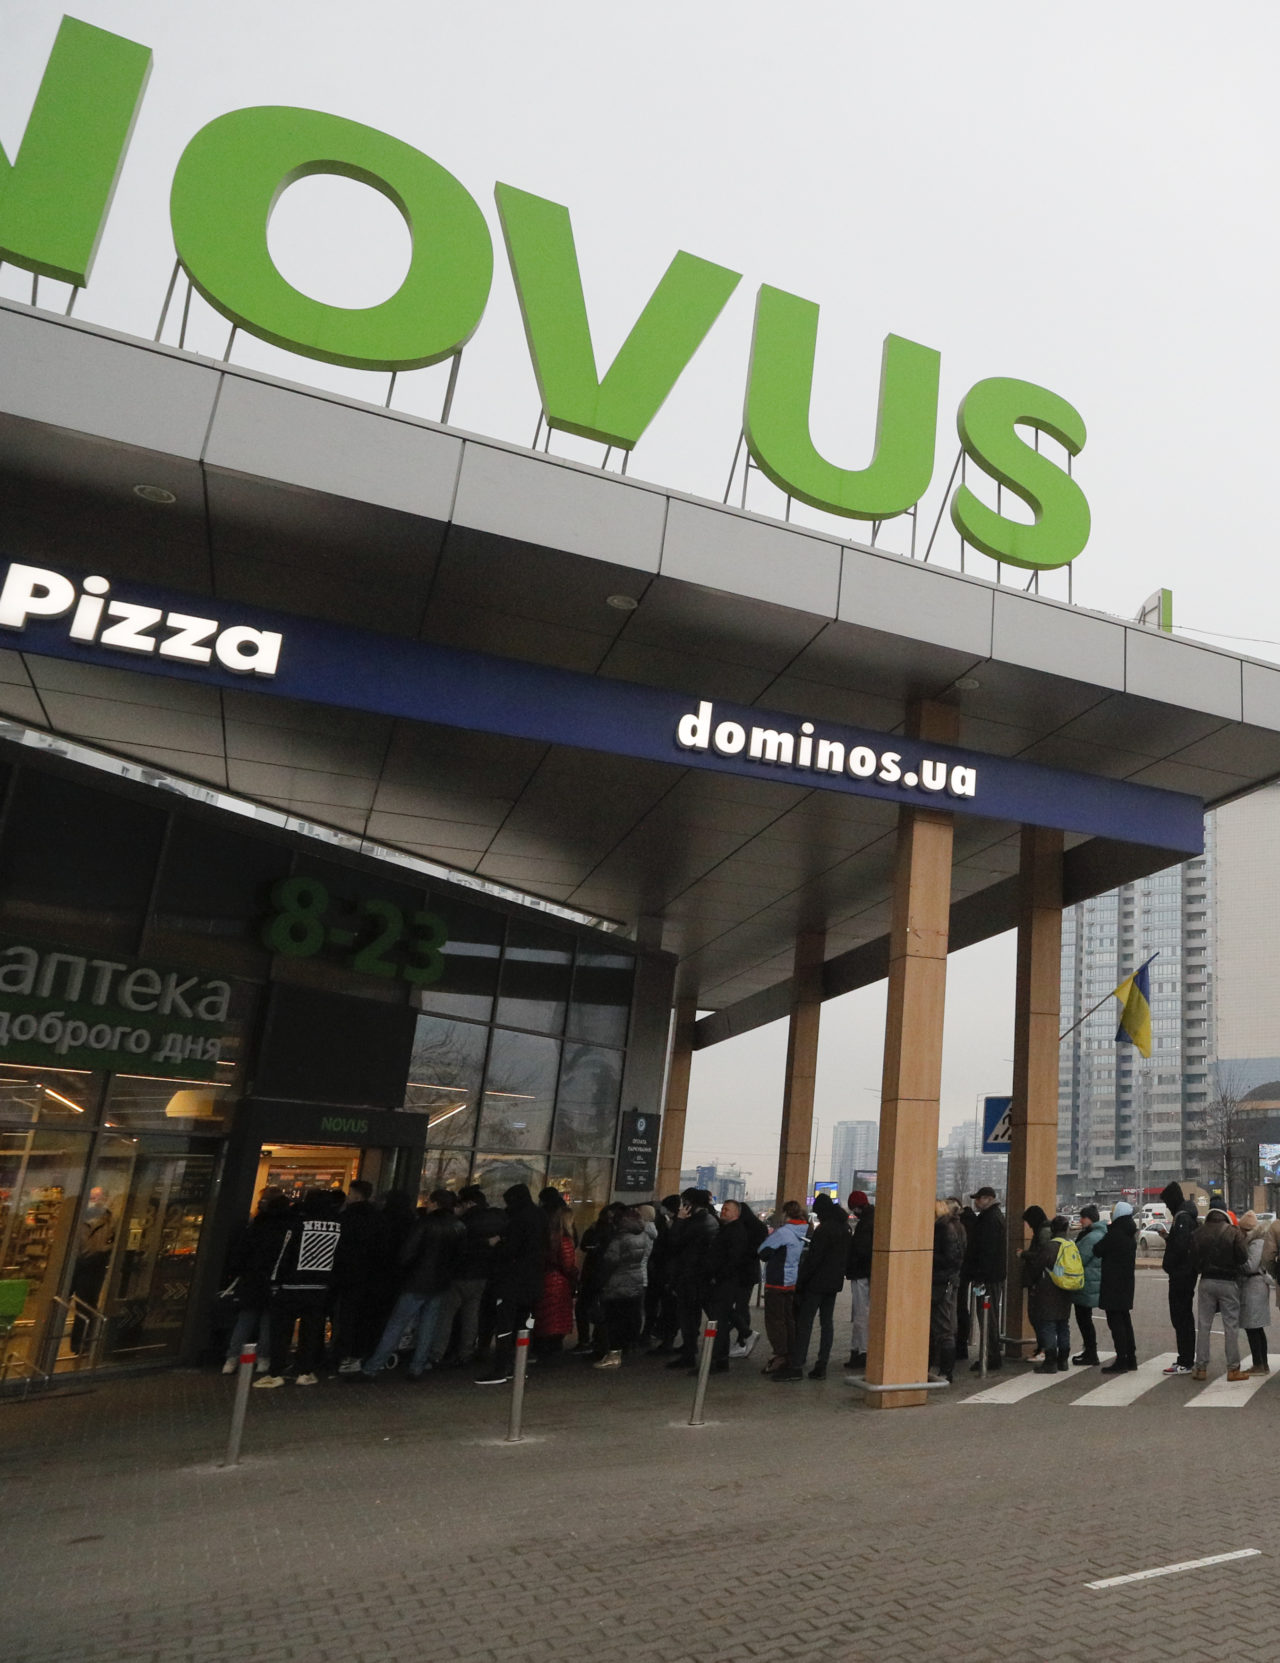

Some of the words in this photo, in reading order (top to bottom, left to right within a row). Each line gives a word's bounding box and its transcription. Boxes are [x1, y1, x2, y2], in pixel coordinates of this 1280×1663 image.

[0, 563, 283, 677] Pizza
[677, 700, 977, 798] dominos.ua
[266, 876, 449, 984] 8-23
[0, 946, 232, 1022] аптека
[153, 1034, 222, 1063] дня
[322, 1117, 368, 1133] NOVUS
[303, 1220, 341, 1232] WHITE
